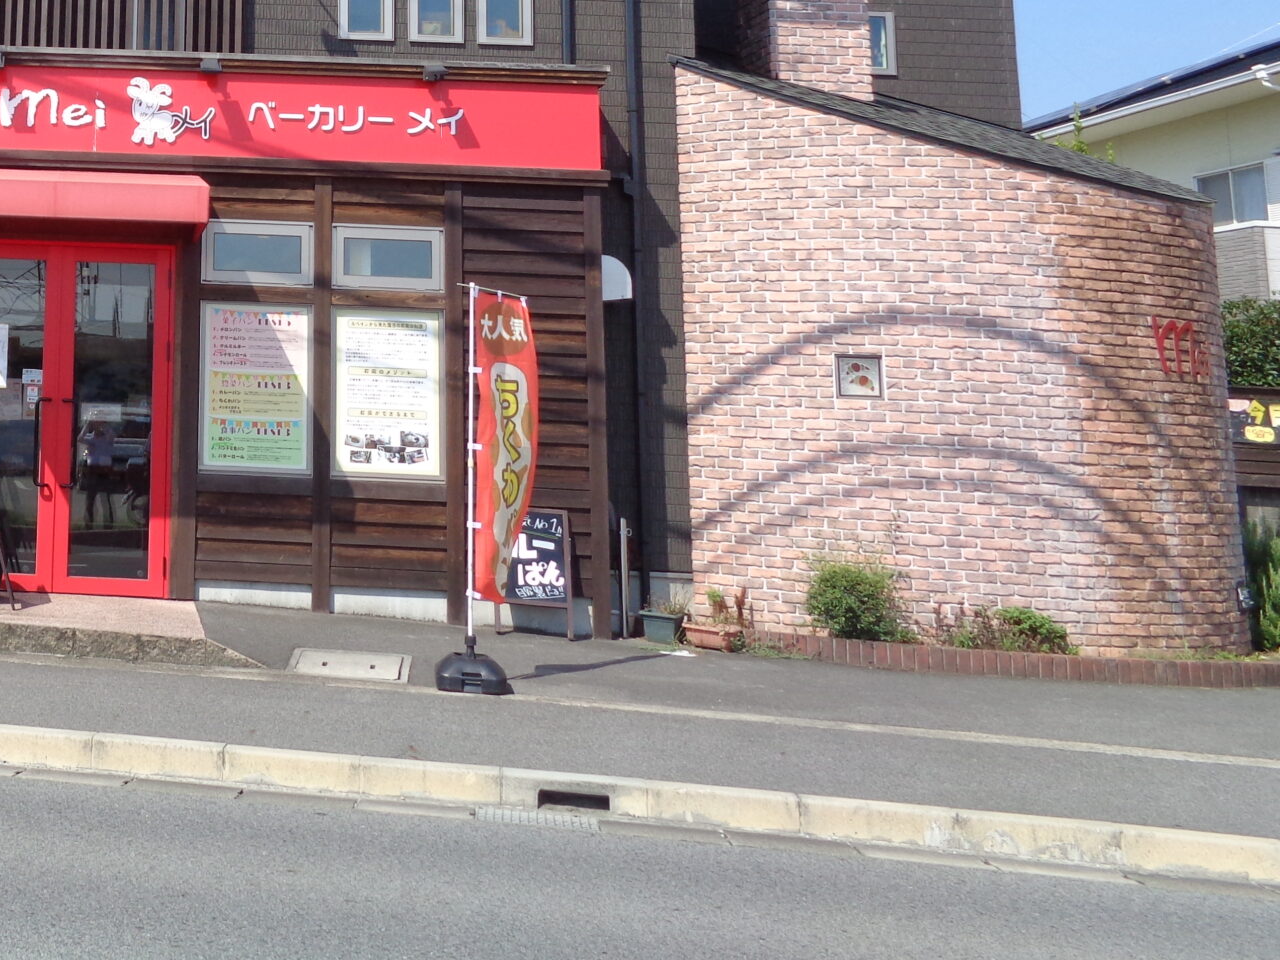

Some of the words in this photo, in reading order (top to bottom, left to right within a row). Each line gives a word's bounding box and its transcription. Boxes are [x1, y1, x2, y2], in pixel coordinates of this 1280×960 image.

[248, 101, 394, 131] ベーカリー
[406, 107, 464, 135] メイ
[517, 560, 565, 587] ぱん
